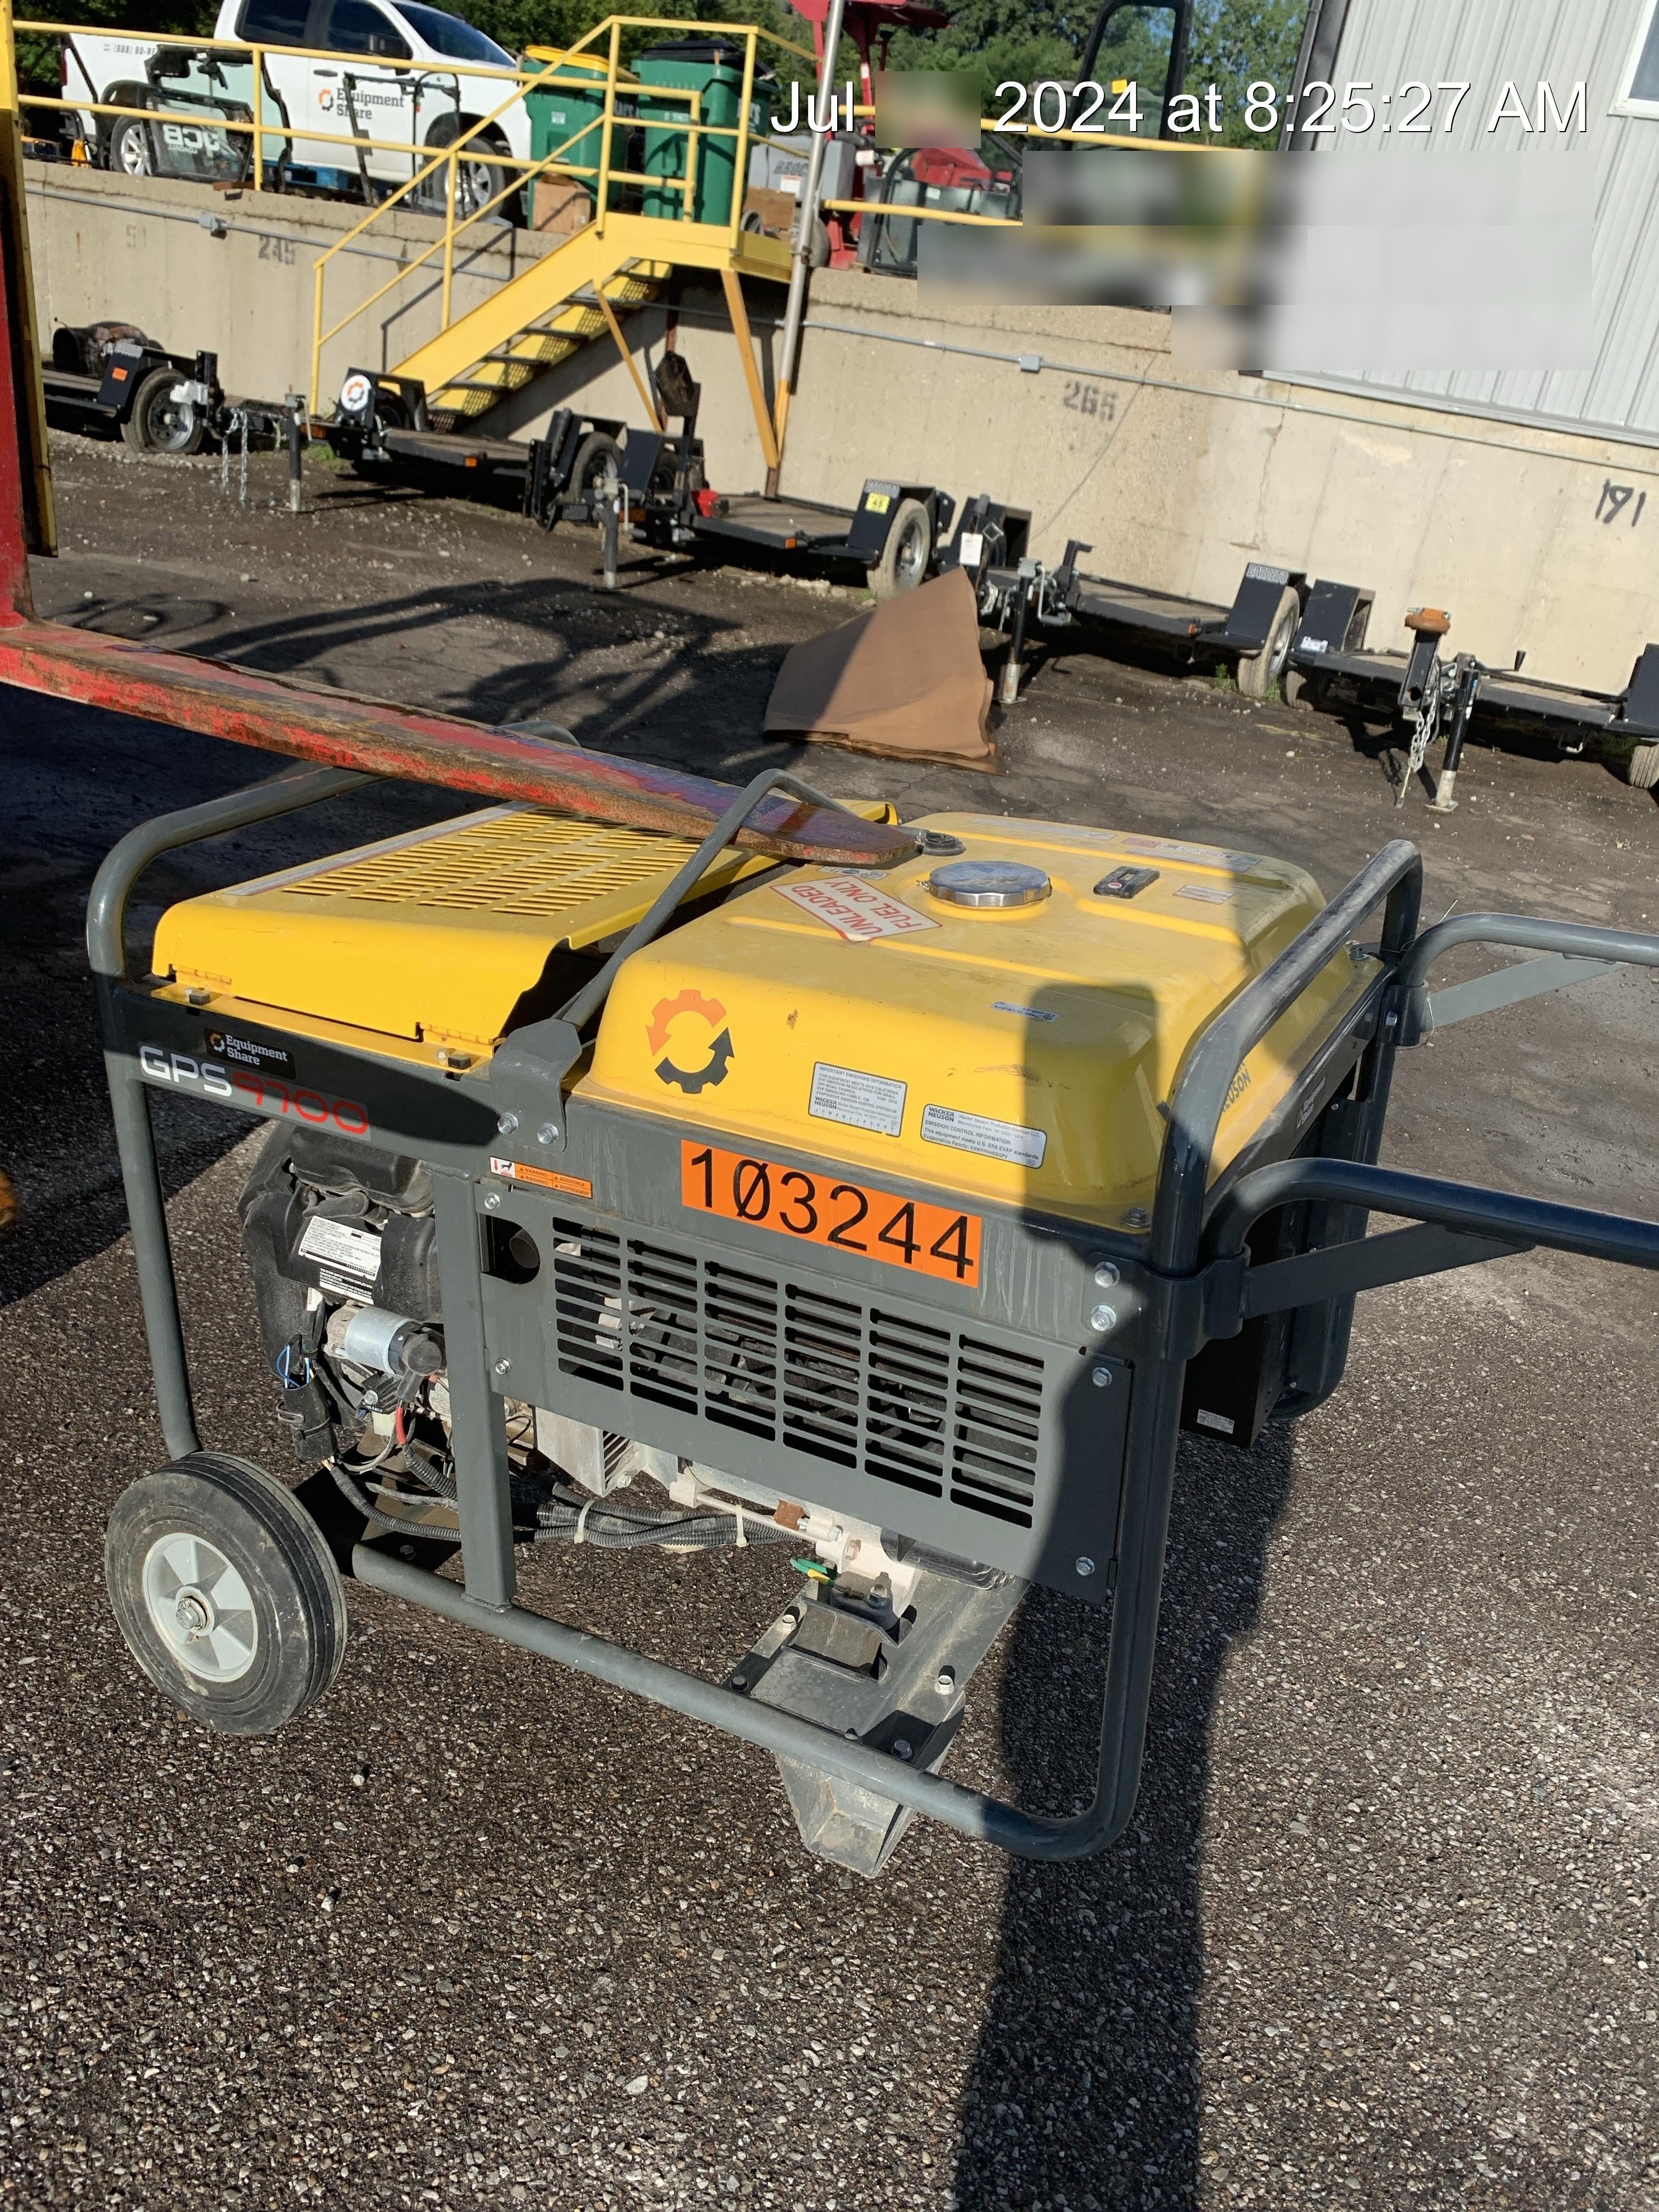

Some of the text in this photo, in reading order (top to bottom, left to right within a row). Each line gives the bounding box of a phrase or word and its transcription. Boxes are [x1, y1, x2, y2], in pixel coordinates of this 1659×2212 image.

[337, 87, 405, 108] Euipment
[774, 161, 809, 177] BROC
[1594, 477, 1646, 527] 191
[791, 885, 883, 935] UNLEADED
[824, 881, 923, 929] FUEL ONLY
[225, 1034, 288, 1062] Equipment
[227, 1047, 260, 1065] Share
[819, 1066, 901, 1088] IMPORTANT EMISSIONS INFORMATION
[814, 1100, 837, 1109] NEUSON
[815, 1096, 837, 1105] WACKER
[928, 1111, 953, 1121] NEUSON
[929, 1107, 954, 1116] WACKER
[923, 1133, 951, 1144] Evaporative
[925, 1119, 1011, 1145] EMISSION CONTROL INFORMATION
[935, 1130, 960, 1141] equipment
[691, 1148, 974, 1279] 103244
